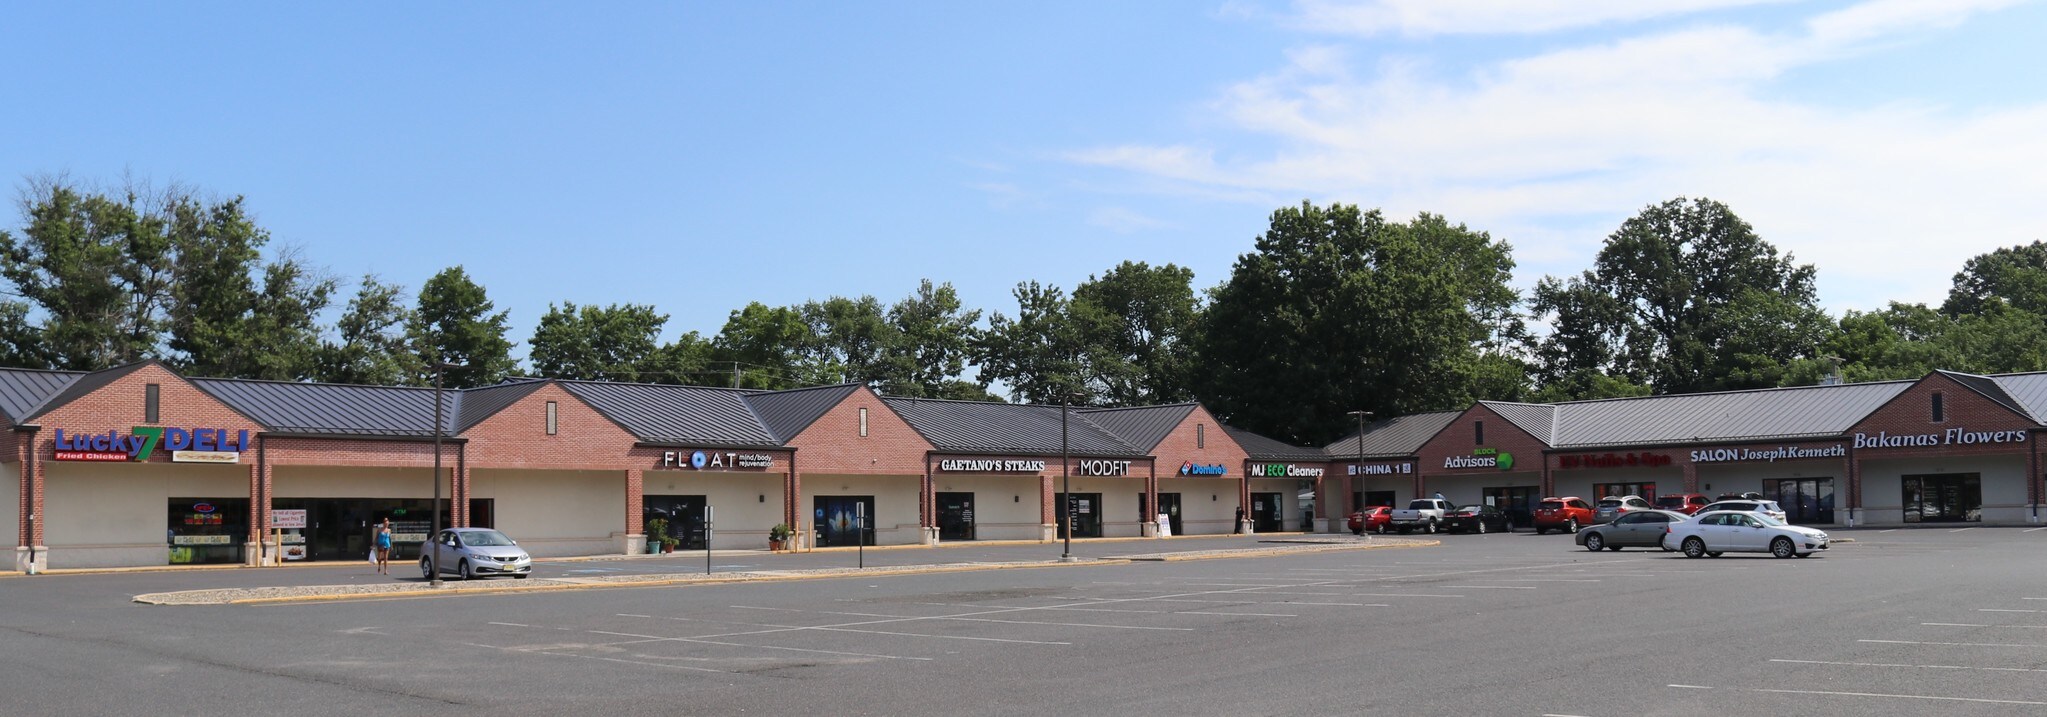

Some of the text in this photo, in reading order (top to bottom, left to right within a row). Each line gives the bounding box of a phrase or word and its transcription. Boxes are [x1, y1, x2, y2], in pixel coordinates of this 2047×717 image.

[55, 426, 248, 461] Lucky 7 DELI
[1853, 428, 2026, 449] Bakanas Flowers
[1444, 455, 1495, 468] Advisors
[1690, 449, 1738, 462] SALON
[739, 460, 774, 468] rejuvenation
[941, 459, 1045, 471] GAETANO'S STEAKS
[1080, 460, 1131, 476] MODFIT
[1192, 463, 1228, 475] Domino's
[1251, 464, 1324, 477] MJ ECO Cleaners
[1358, 464, 1392, 475] CHINA
[1394, 464, 1400, 474] 1
